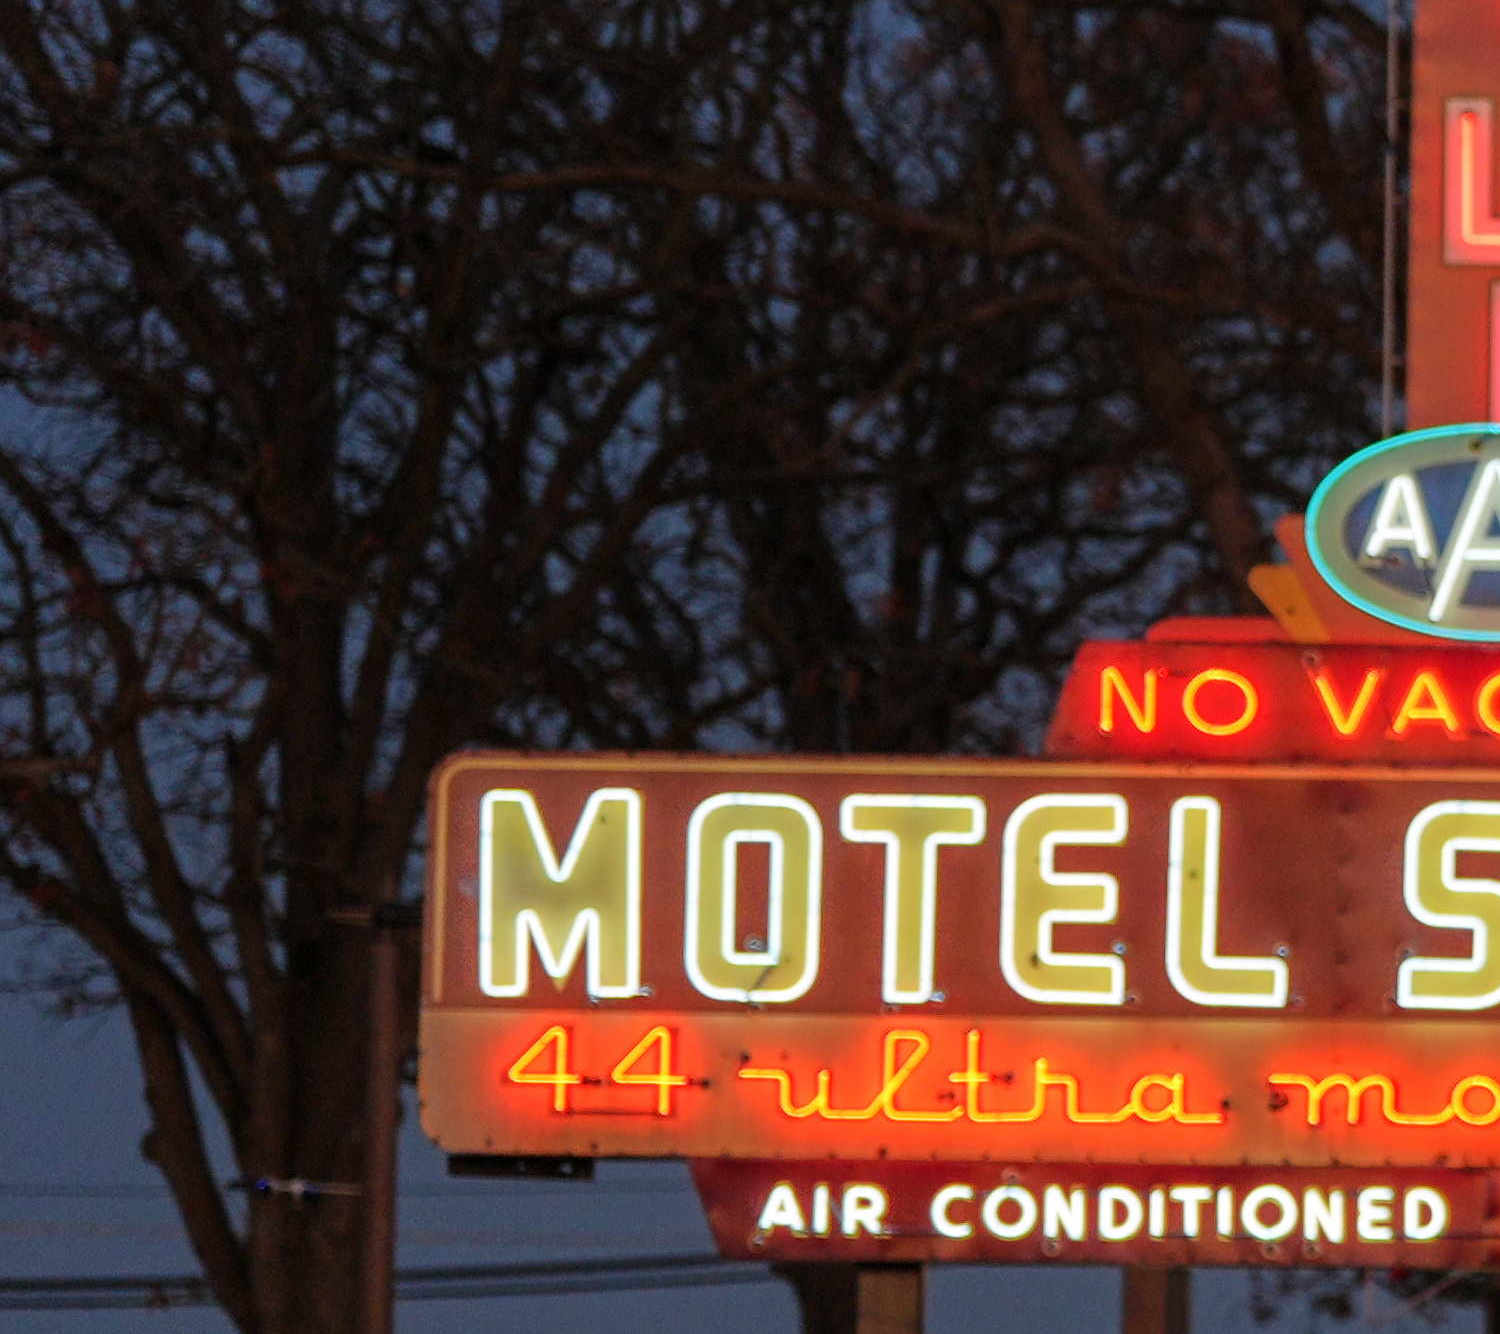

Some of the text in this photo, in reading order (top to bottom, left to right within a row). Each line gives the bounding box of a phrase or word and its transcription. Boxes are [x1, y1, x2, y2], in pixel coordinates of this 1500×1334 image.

[1098, 666, 1259, 737] NO
[478, 786, 1291, 1009] MOTEL
[506, 1024, 688, 1115] 44
[738, 1027, 1222, 1126] ultra
[757, 1179, 890, 1236] AIR
[930, 1183, 1448, 1243] CONDITIONED
